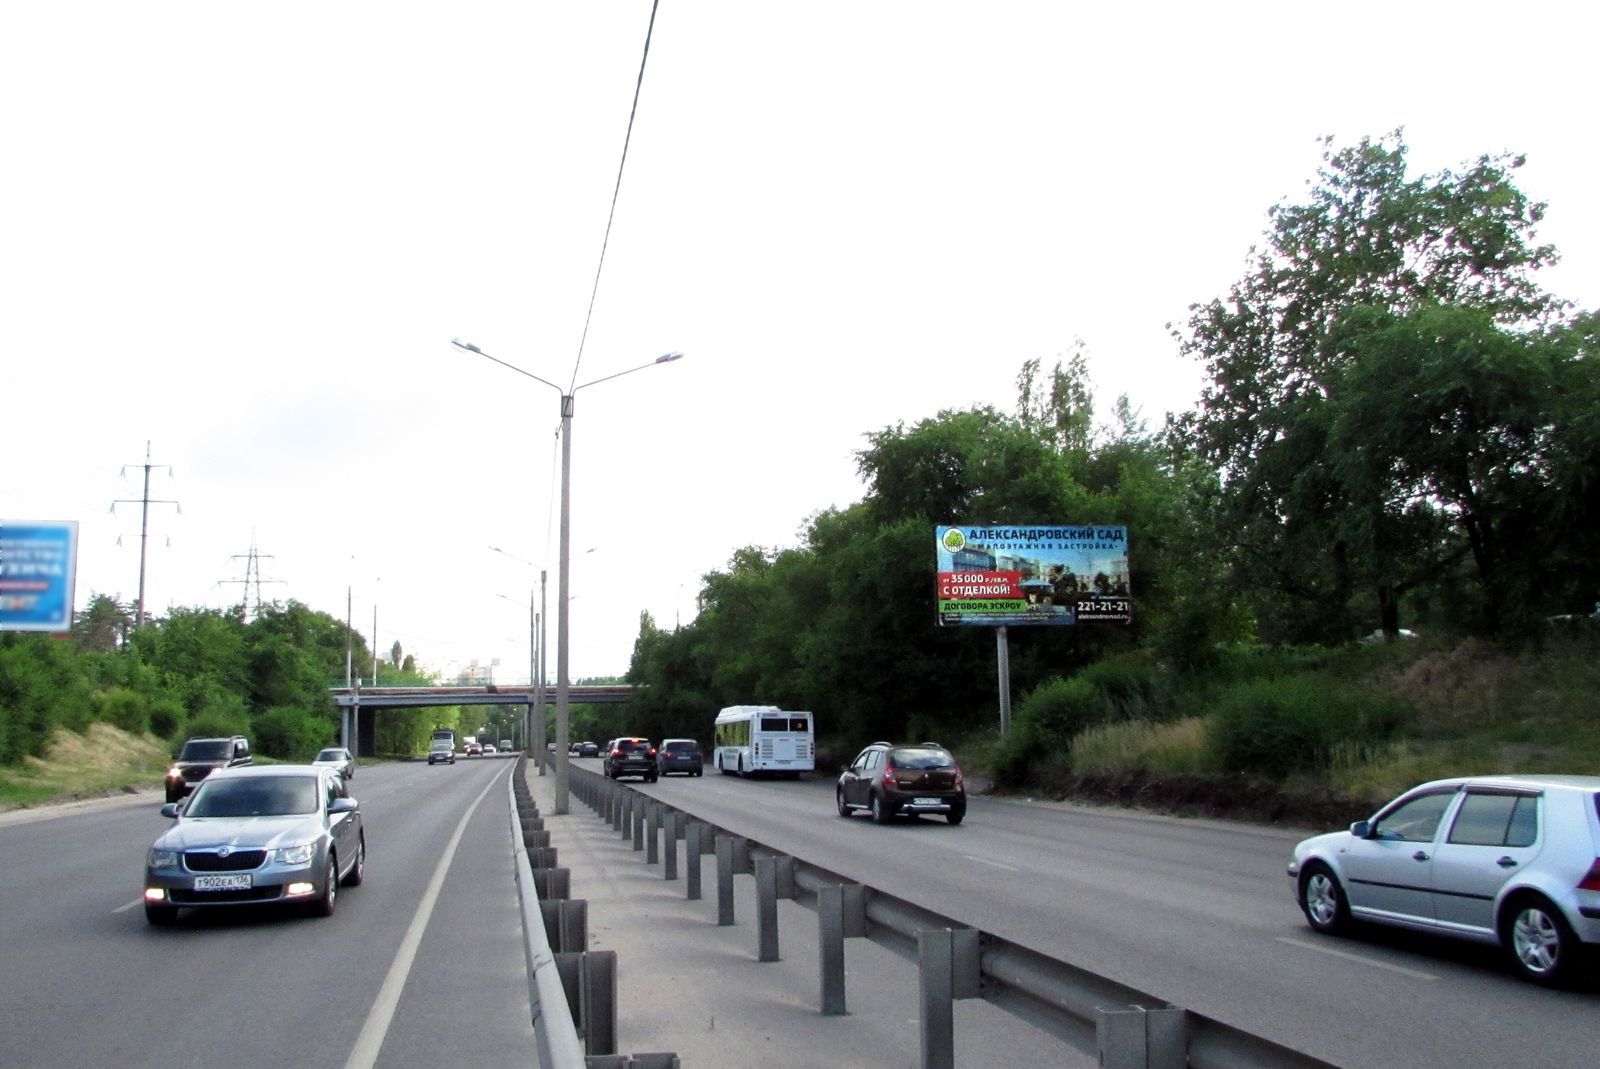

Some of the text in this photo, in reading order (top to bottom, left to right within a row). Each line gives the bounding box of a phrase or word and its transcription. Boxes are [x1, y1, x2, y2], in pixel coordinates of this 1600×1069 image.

[969, 527, 1123, 541] АЛЕКСАНДРОВСКИЙ САД
[943, 584, 1010, 596] С ОТДЕЛКОЙ!
[944, 602, 1021, 611] ДОГОВОРА ЭСКРОУ
[1077, 601, 1128, 611] 221-21-21
